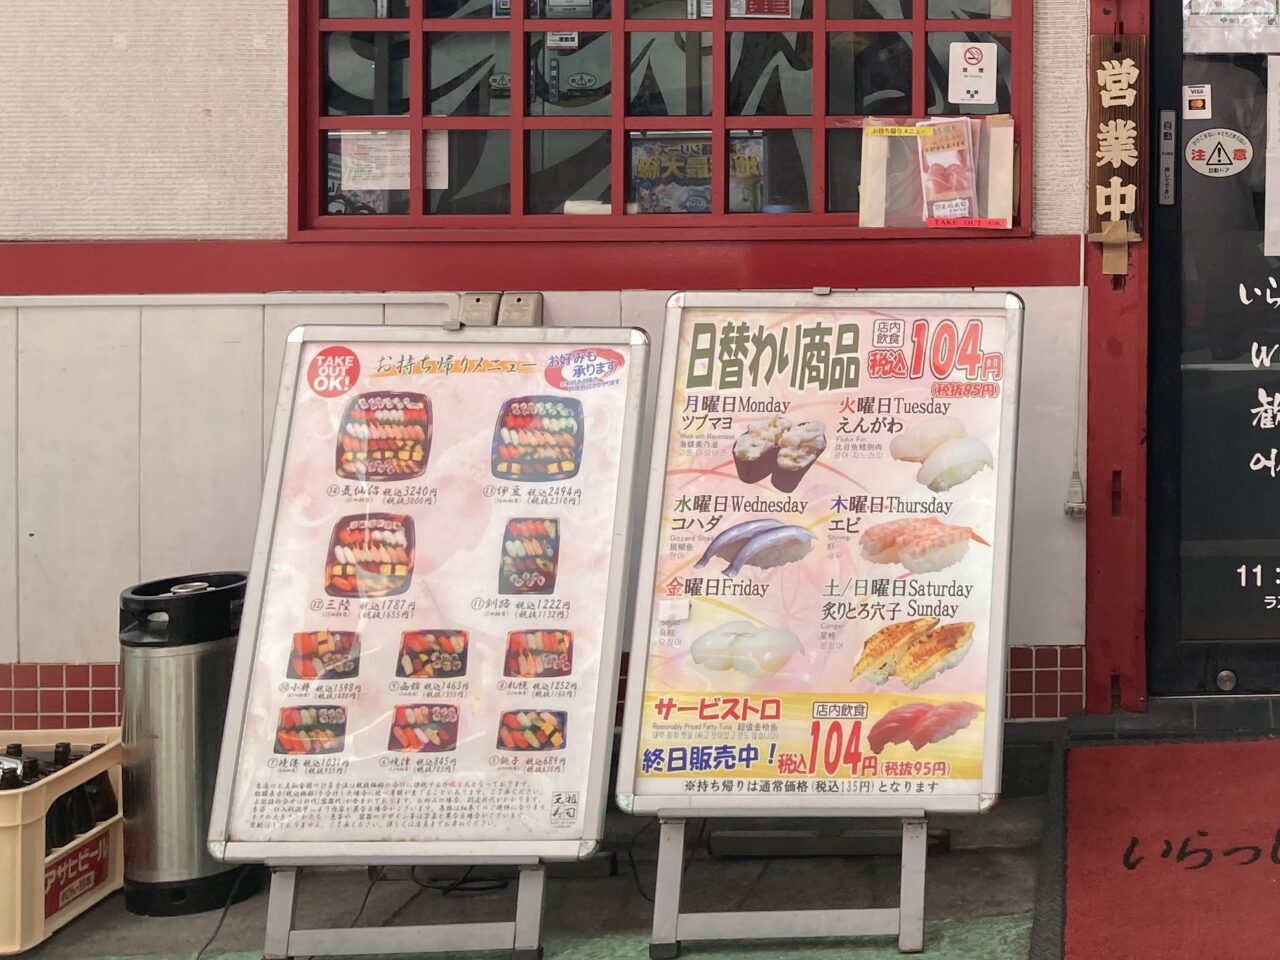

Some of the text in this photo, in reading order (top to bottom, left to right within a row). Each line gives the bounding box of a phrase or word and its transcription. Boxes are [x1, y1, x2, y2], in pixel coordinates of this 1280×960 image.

[1095, 57, 1140, 222] 営業中
[935, 219, 957, 227] TAKE
[964, 219, 982, 227] OUT
[316, 355, 355, 367] TAKE
[377, 353, 538, 376] お持ち帰りメニュー
[548, 350, 597, 368] お好みも
[686, 320, 861, 391] 日替わり商品
[318, 366, 349, 377] OUT
[572, 361, 617, 378] 承ります
[313, 376, 350, 391] OK!
[681, 414, 733, 432] ツブマヨ
[836, 416, 904, 435] えんがわ
[671, 515, 722, 533] コハダ
[828, 517, 860, 534] エビ
[821, 600, 960, 622] 炙りとろ穴子 Sunday
[654, 697, 782, 722] サービストロ
[815, 703, 867, 718] 店内飲食
[880, 760, 951, 778] (税抜95円)
[45, 838, 108, 896] アサヒビール
